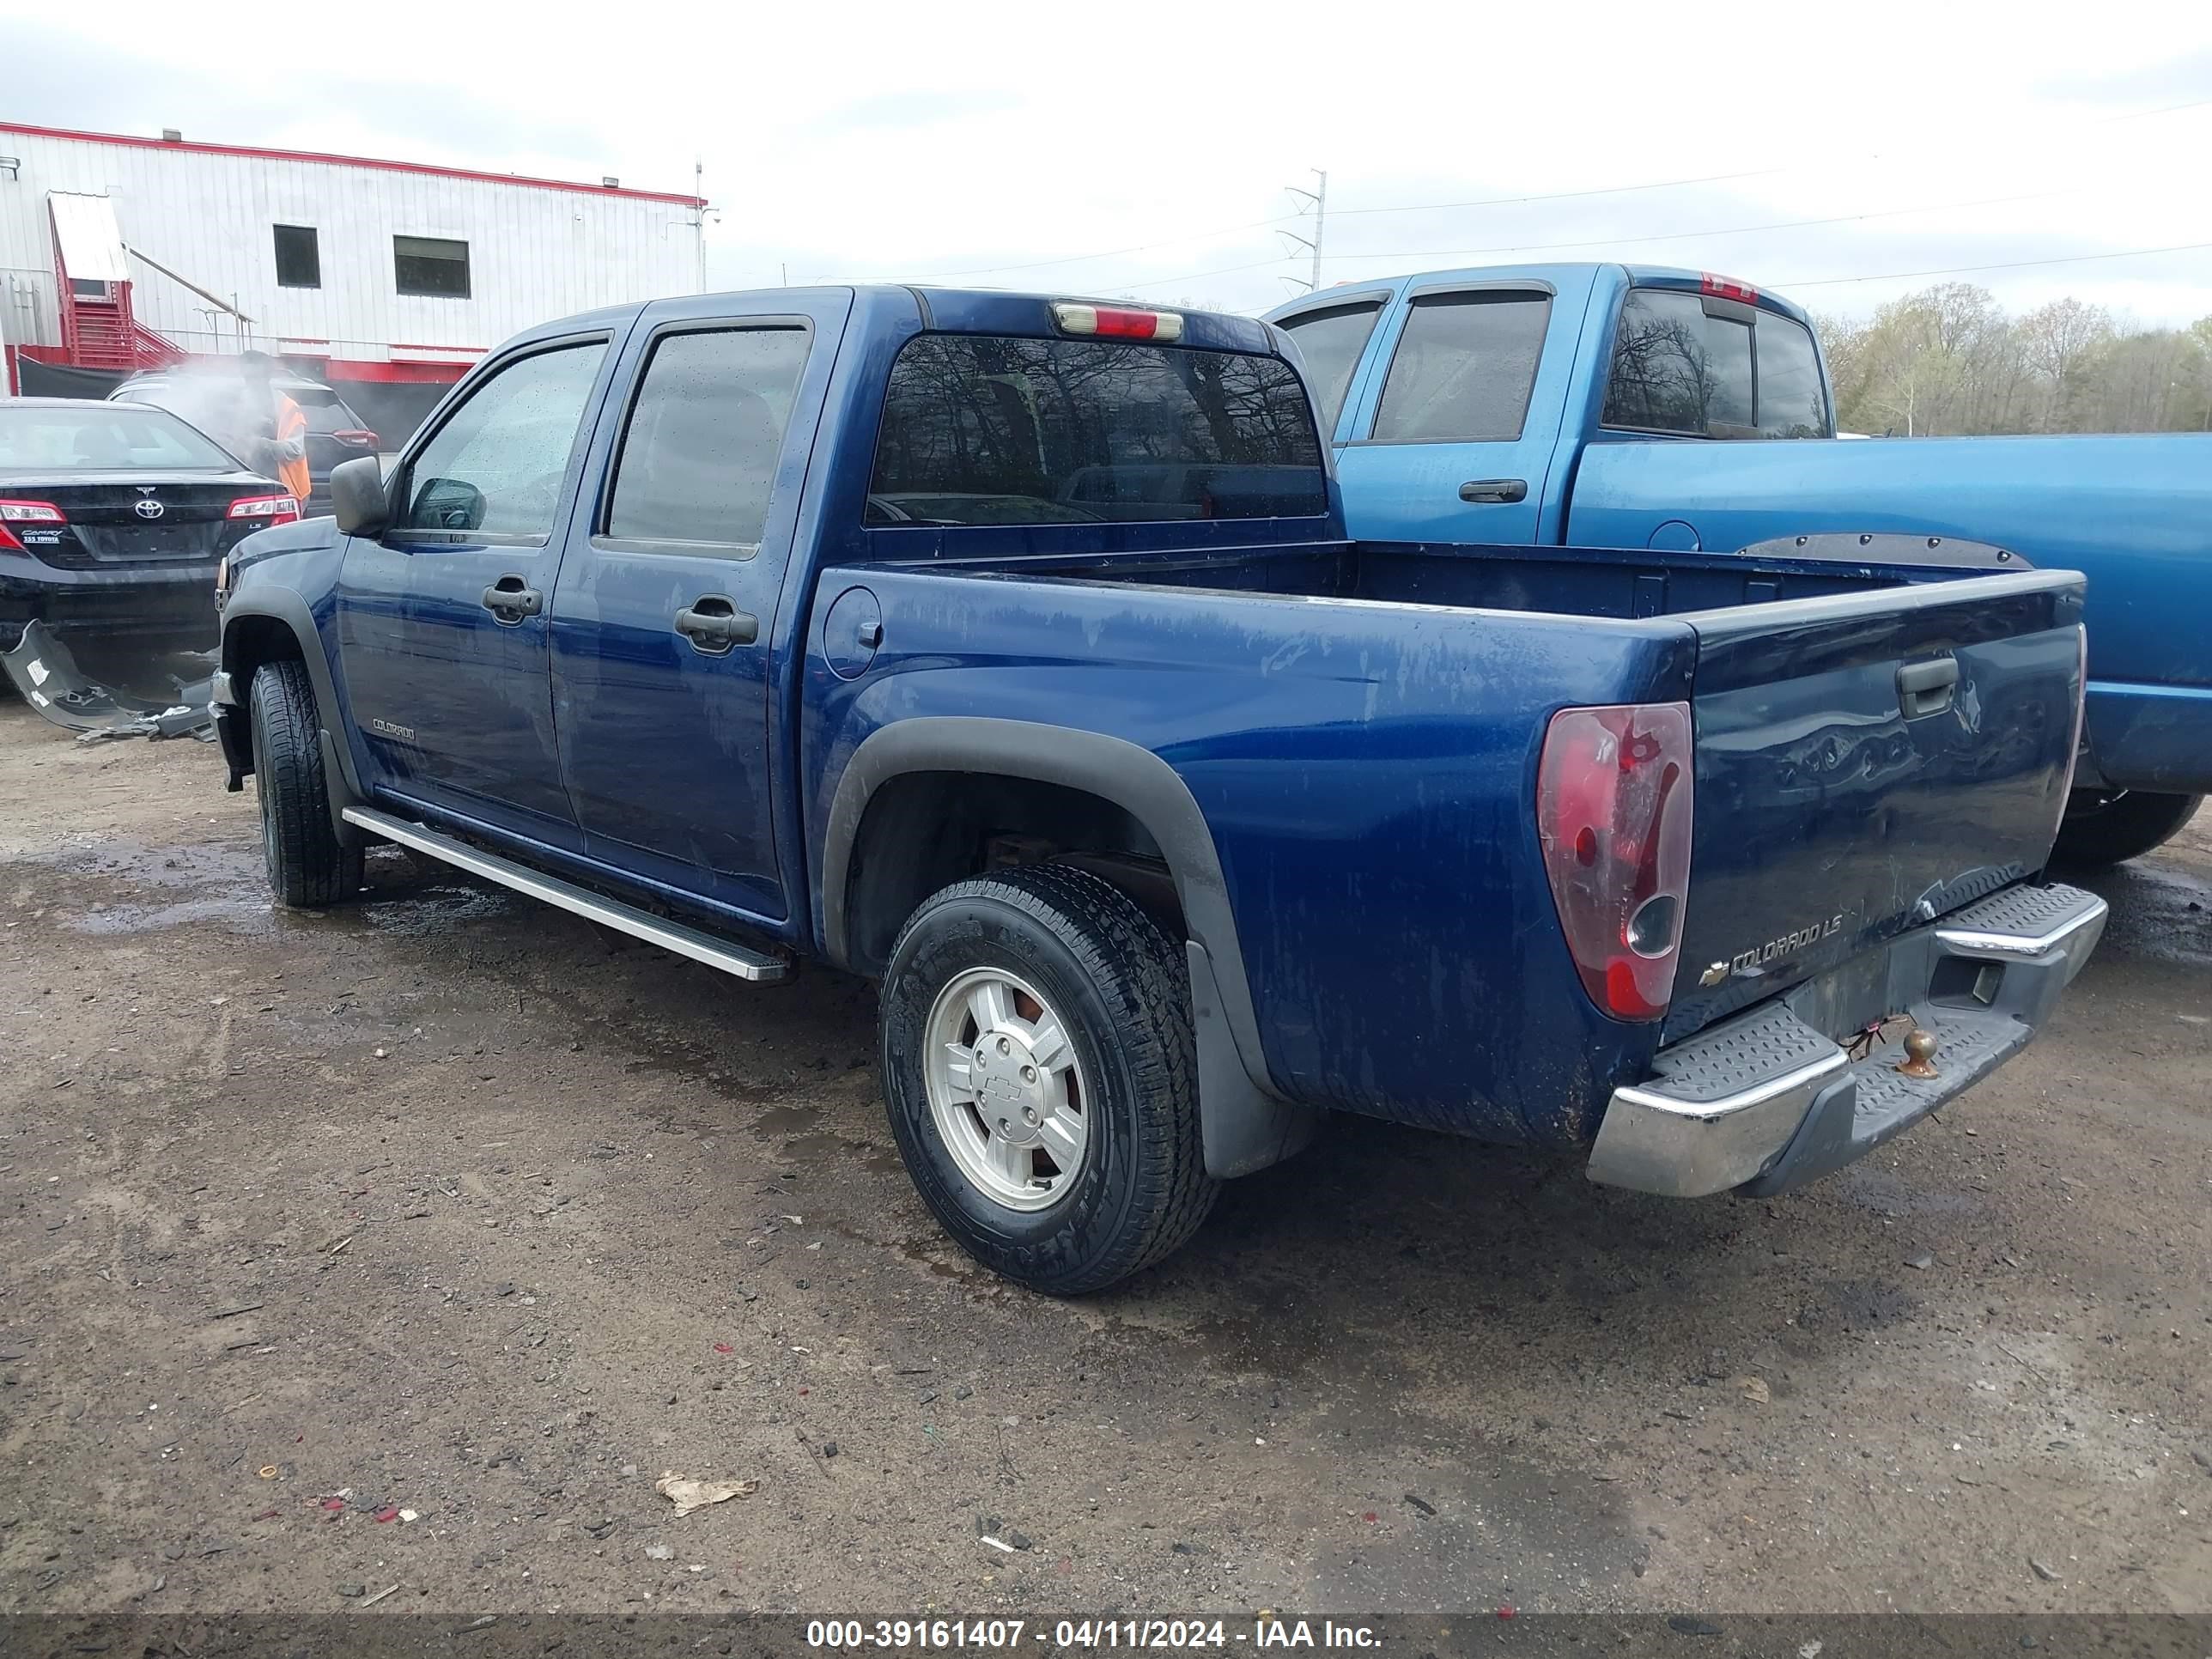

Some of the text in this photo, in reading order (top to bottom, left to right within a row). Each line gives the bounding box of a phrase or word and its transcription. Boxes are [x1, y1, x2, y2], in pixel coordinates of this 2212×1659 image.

[373, 719, 415, 739] COLORADO
[1731, 915, 1844, 975] COLORADO LS
